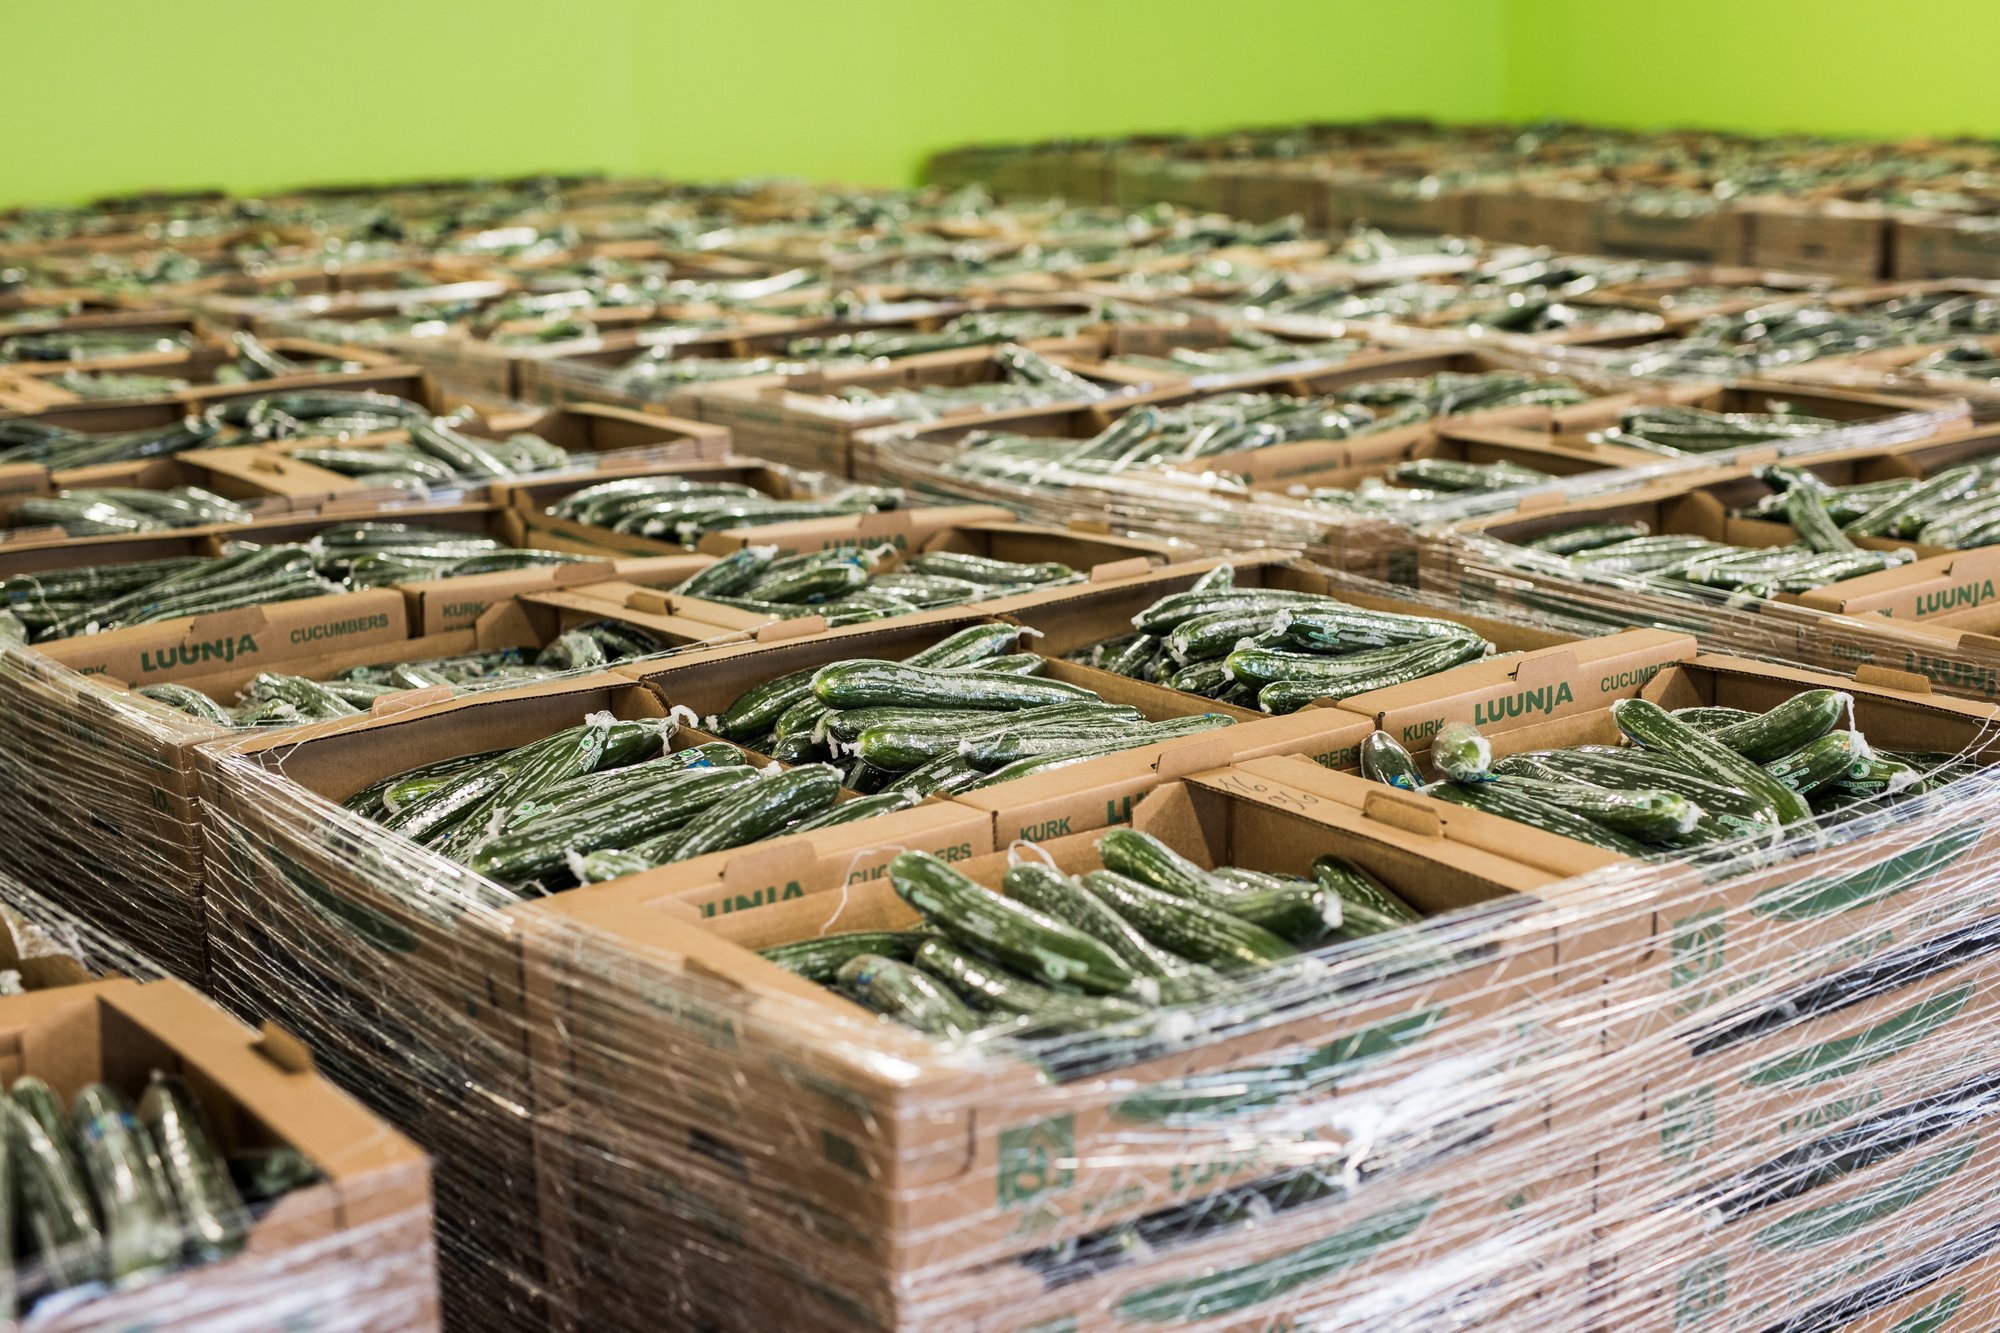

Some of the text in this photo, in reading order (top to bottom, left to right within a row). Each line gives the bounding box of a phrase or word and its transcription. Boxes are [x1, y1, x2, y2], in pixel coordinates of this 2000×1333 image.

[441, 602, 485, 618] KURK
[1916, 579, 1995, 616] LUUNJA
[140, 613, 389, 673] LUUNJA CUCUMBERS
[1402, 658, 1684, 743] KURK LUUNJA CUCUM
[1020, 815, 1071, 842] KURK
